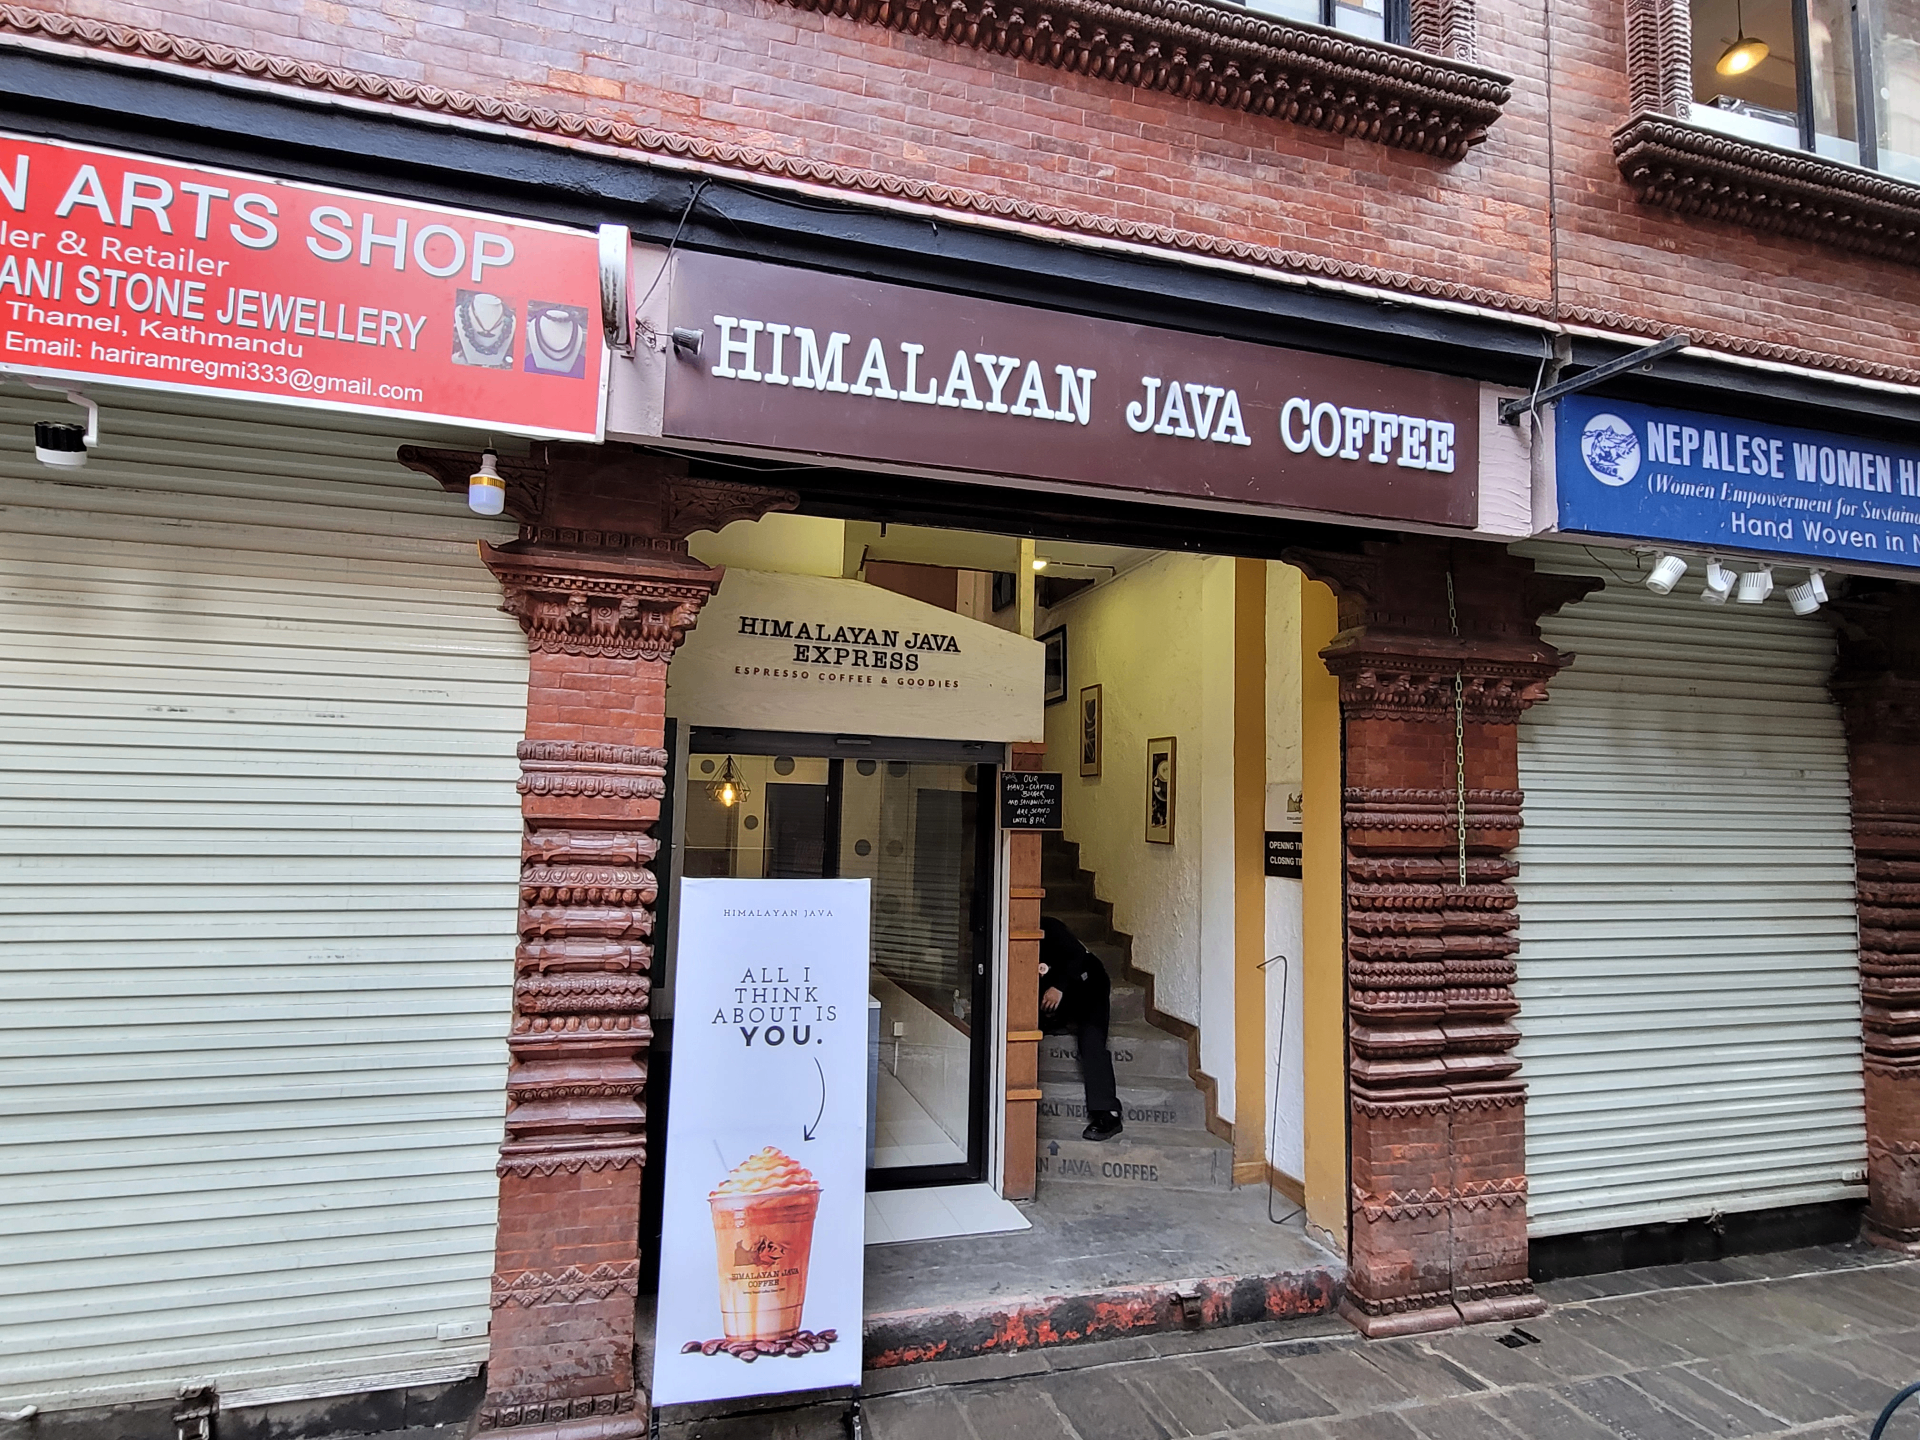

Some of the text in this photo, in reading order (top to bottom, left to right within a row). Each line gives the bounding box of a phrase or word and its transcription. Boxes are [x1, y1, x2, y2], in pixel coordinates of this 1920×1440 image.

[55, 164, 279, 249] ARTS
[306, 205, 515, 283] SHOP
[57, 230, 88, 257] &
[101, 237, 230, 278] Retailer
[0, 255, 427, 351] ANI STONE JEWELLERY
[6, 300, 304, 359] Thamel, Kathmandu
[6, 330, 424, 403] Email: hariramregmi333@gmail.com
[711, 314, 1456, 474] HIMALAYAN JAVA COFFEE
[1647, 421, 1920, 497] NEPALESE WOMEN H
[1648, 472, 1715, 499] (Women
[1720, 482, 1832, 513] Empowerment
[1834, 497, 1858, 519] for
[1732, 511, 1793, 540] Hand
[1802, 519, 1877, 548] Woven
[1885, 530, 1904, 552] in
[737, 615, 961, 653] HIMALAYAN JAVA
[793, 644, 920, 672] EXPRESS
[734, 666, 960, 689] ESPRESSO COFFEE & GOODIES
[1024, 775, 1039, 785] OUR
[1269, 841, 1294, 850] OPENING
[1269, 855, 1294, 865] CLOSING
[724, 909, 834, 917] HIMALAYAN JAVA
[741, 967, 810, 984] ALL I
[735, 987, 818, 1004] THINK
[712, 1005, 837, 1024] ABOUT IS
[739, 1025, 823, 1047] YOU.
[1127, 1108, 1177, 1124] COFFEE
[1058, 1158, 1094, 1177] JAVA
[1102, 1161, 1159, 1181] COFFEE
[748, 1279, 779, 1288] COFFEE
